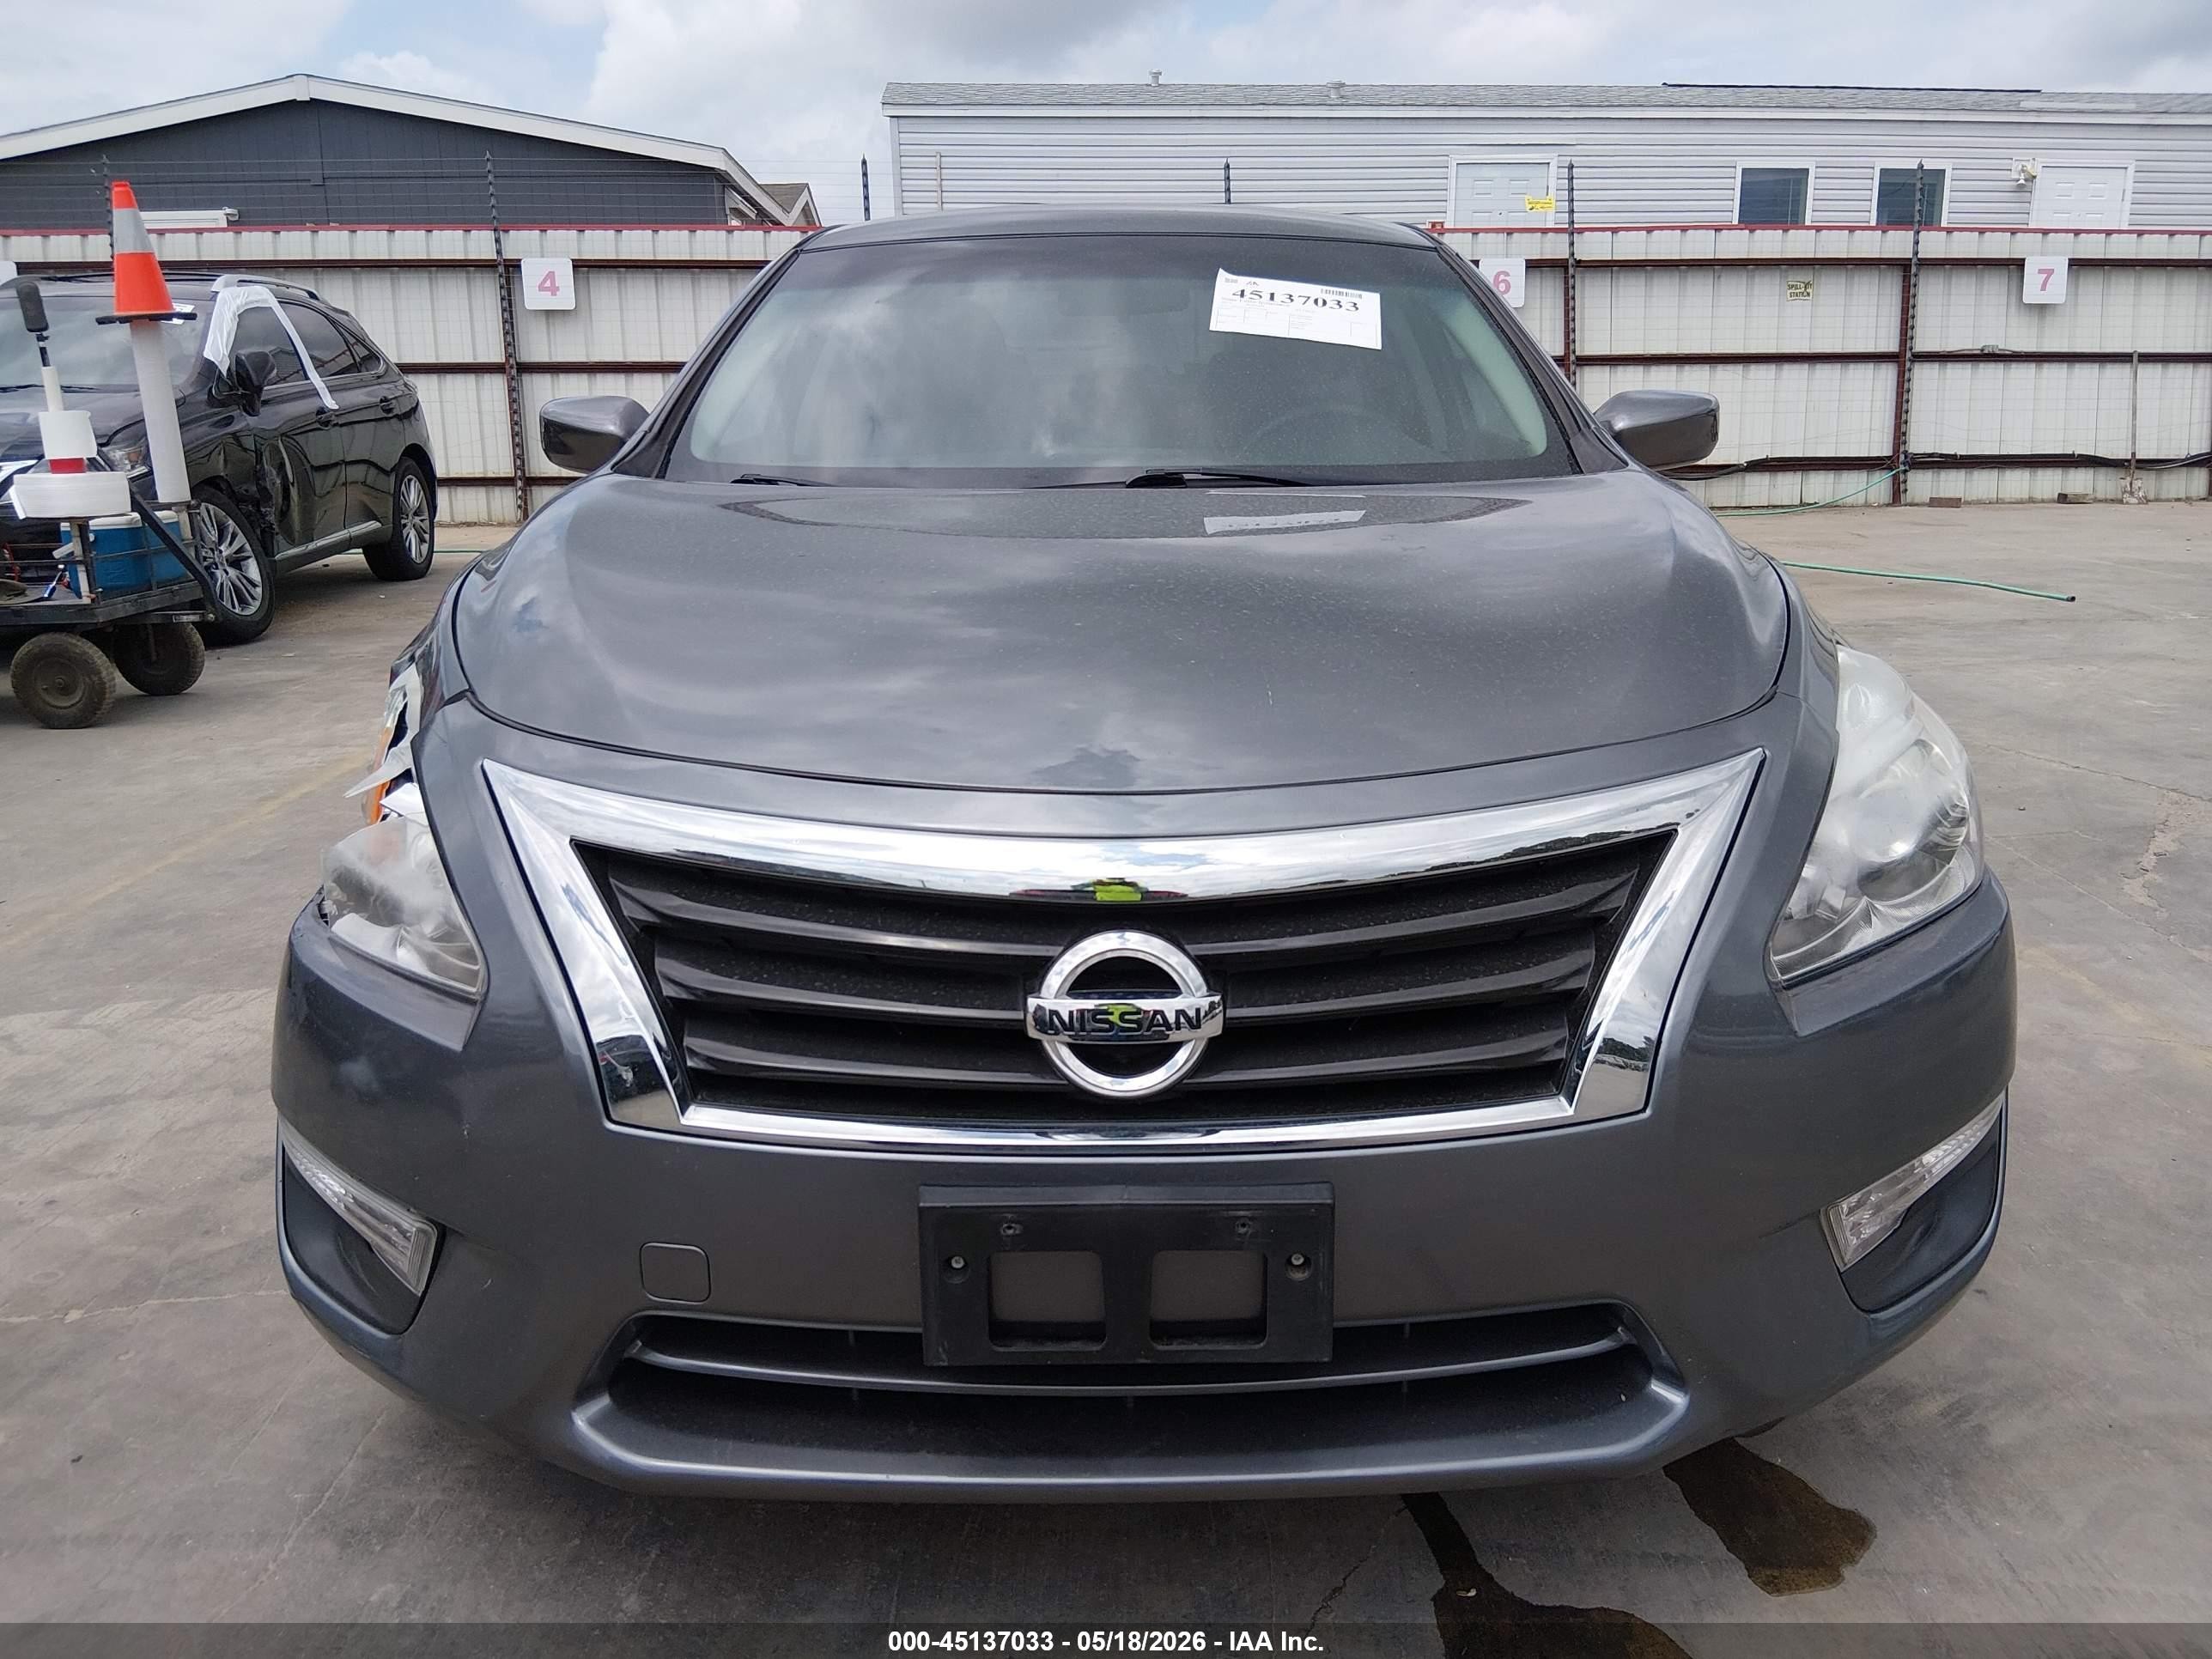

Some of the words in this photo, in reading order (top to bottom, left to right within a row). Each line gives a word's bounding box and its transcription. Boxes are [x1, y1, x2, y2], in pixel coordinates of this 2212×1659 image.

[538, 270, 561, 297] 4
[1493, 270, 1511, 295] 6
[2037, 268, 2055, 292] 7
[1231, 289, 1360, 313] 45137033
[1048, 1007, 1201, 1034] NISSAN
